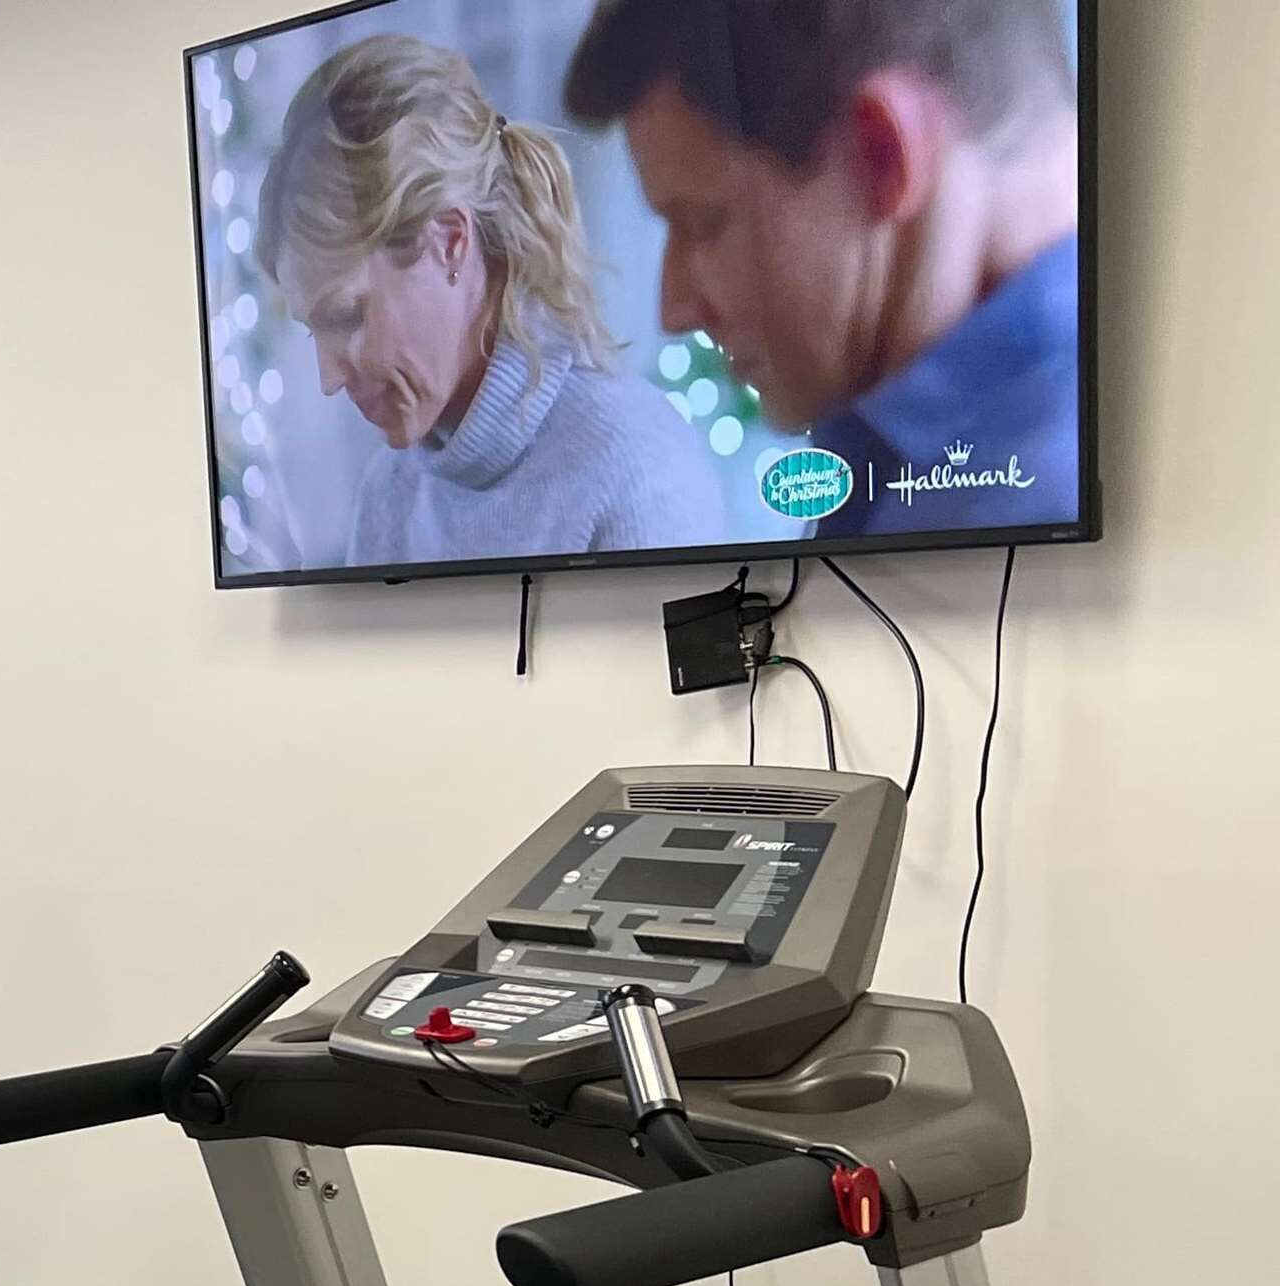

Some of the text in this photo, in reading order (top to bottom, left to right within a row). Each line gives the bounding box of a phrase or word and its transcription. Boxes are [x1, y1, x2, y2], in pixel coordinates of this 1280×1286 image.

[769, 468, 839, 488] Countdown
[886, 455, 1036, 507] Hallmark
[779, 483, 841, 504] Christmas
[745, 841, 796, 851] SPIRIT
